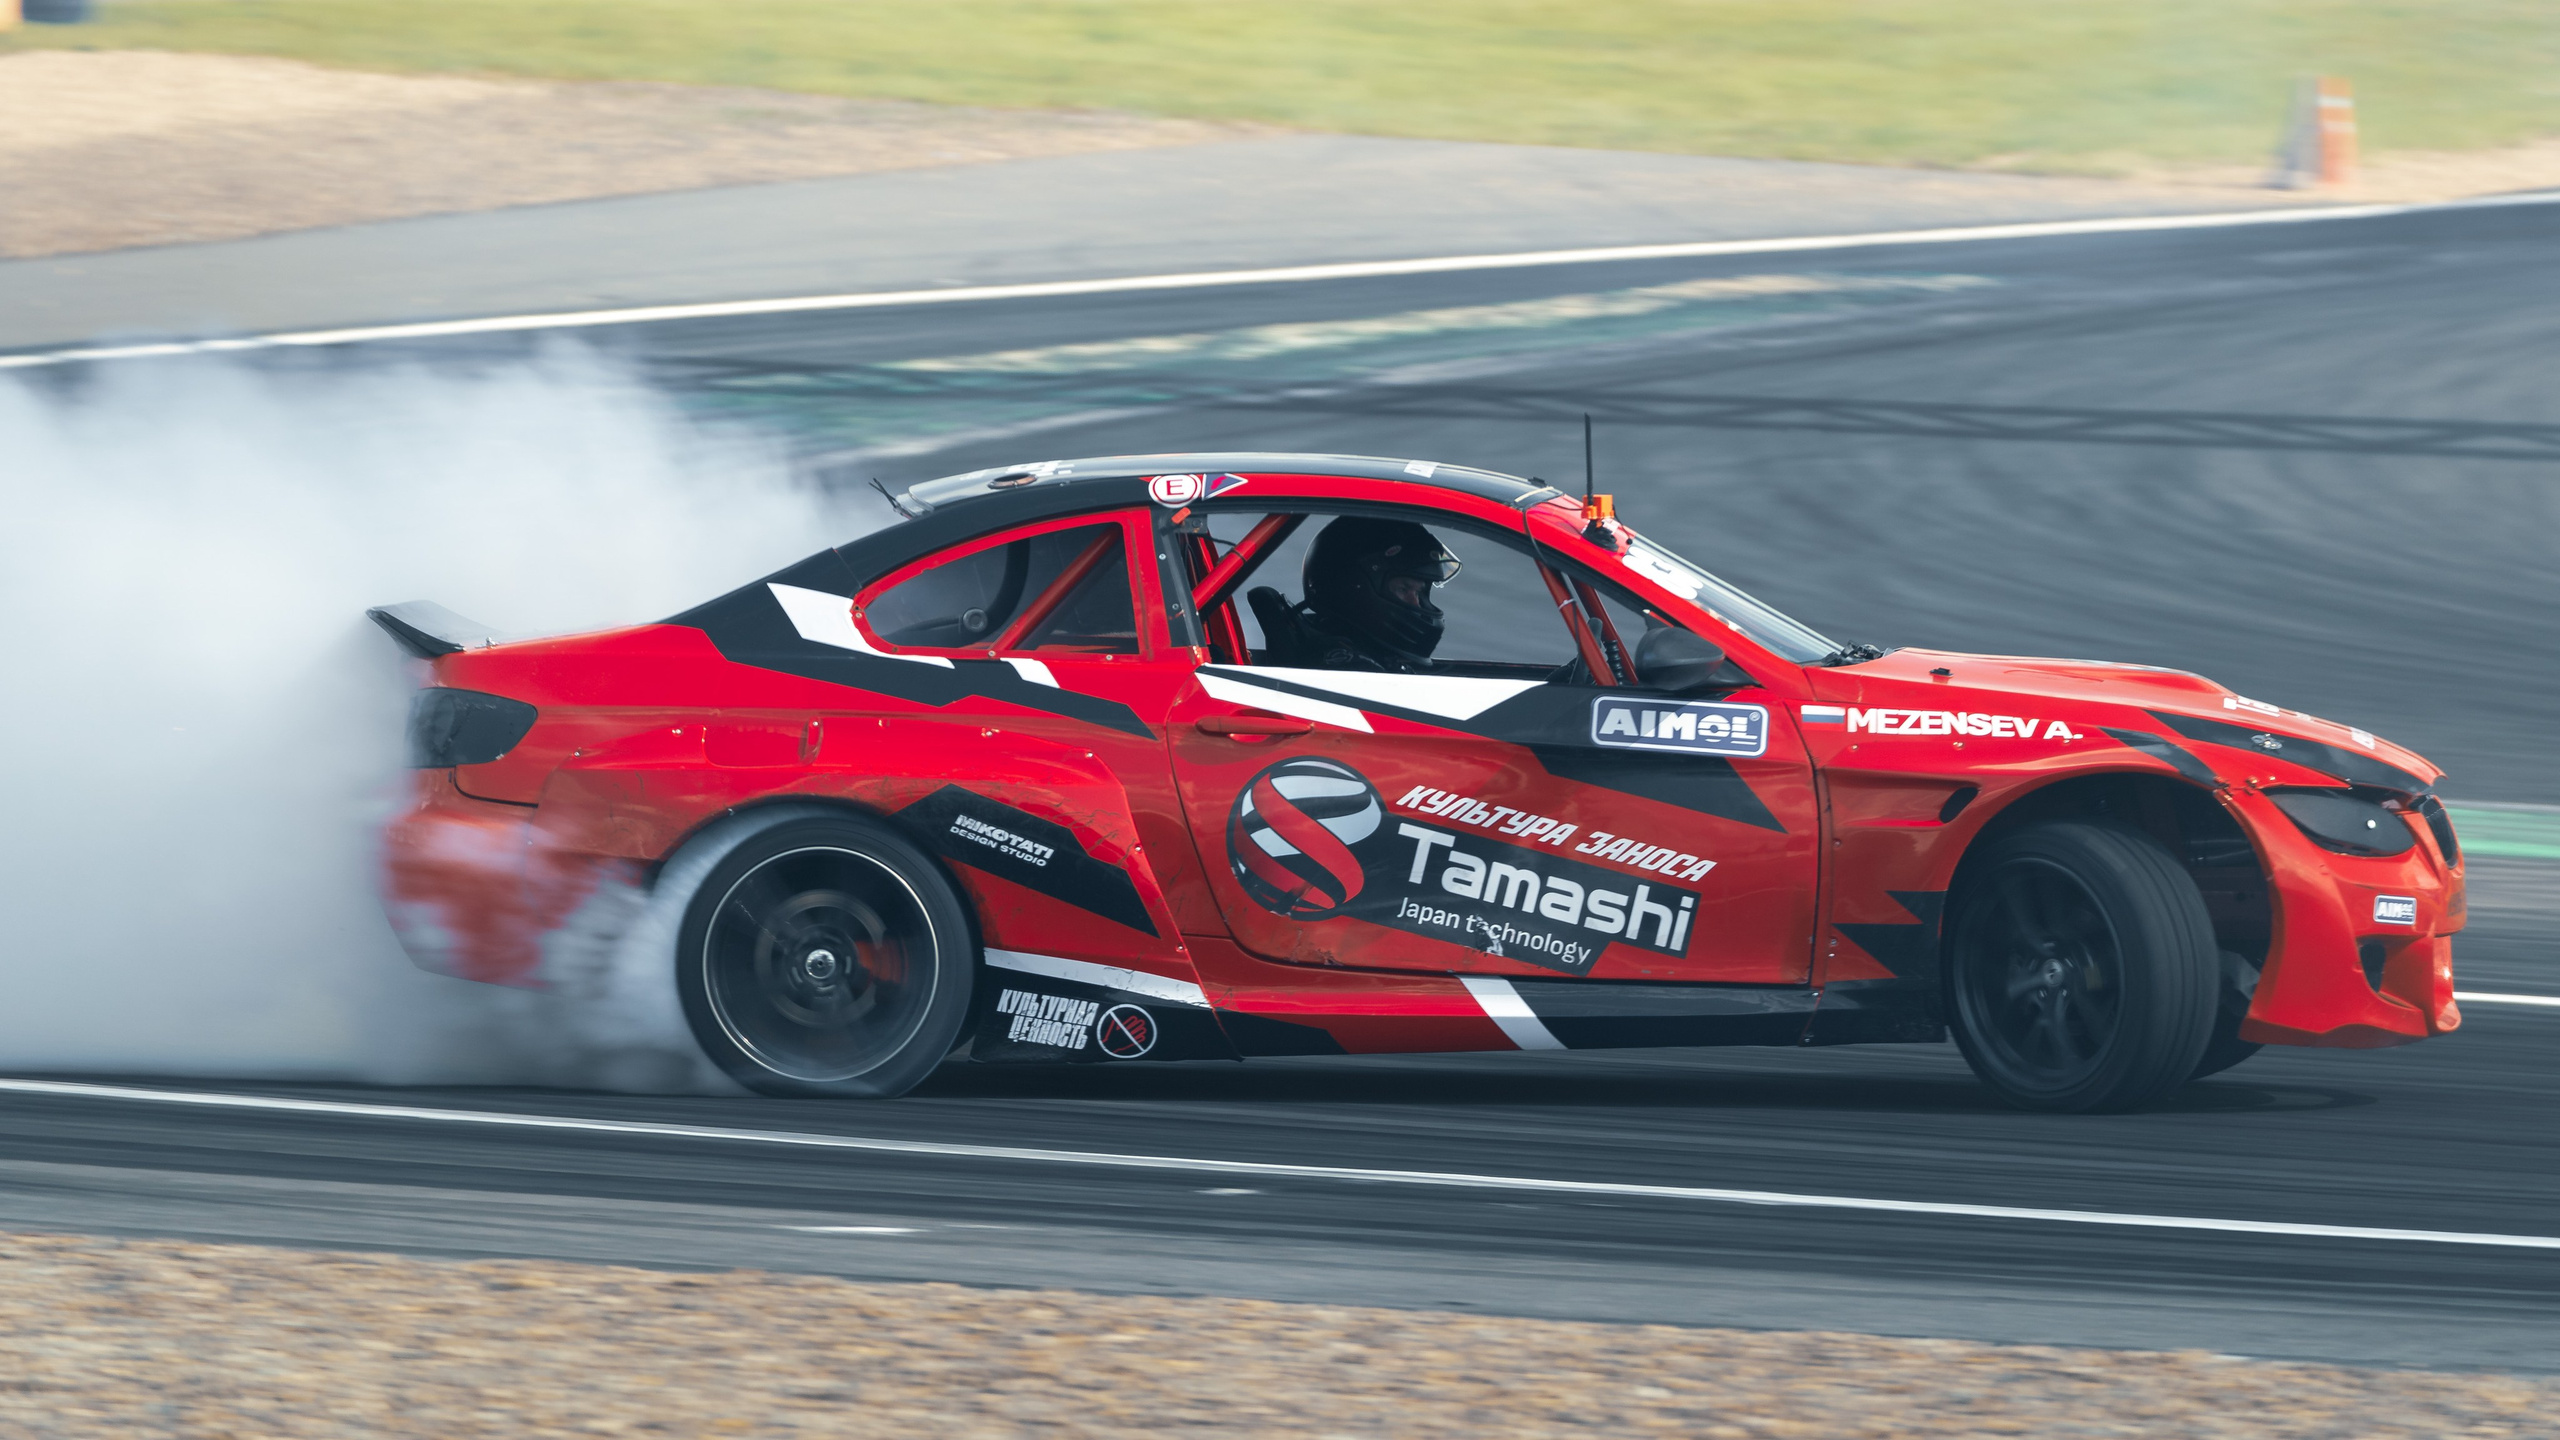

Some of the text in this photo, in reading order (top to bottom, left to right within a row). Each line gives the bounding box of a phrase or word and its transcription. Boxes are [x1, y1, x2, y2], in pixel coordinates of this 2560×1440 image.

[1599, 708, 1758, 745] AIMOL
[1848, 708, 2083, 739] MEZENSEV A.
[950, 826, 1047, 867] DESIGN STUDIO
[955, 815, 1055, 859] MIKOTATI
[1396, 785, 1717, 882] КУЛЬТУРА ЗАНОСА
[1398, 823, 1695, 951] Tamashi
[1397, 897, 1460, 929] Japan
[997, 989, 1100, 1026] КУЛЬТУРНАЯ
[1008, 1015, 1088, 1050] ЦЕННОСТЬ
